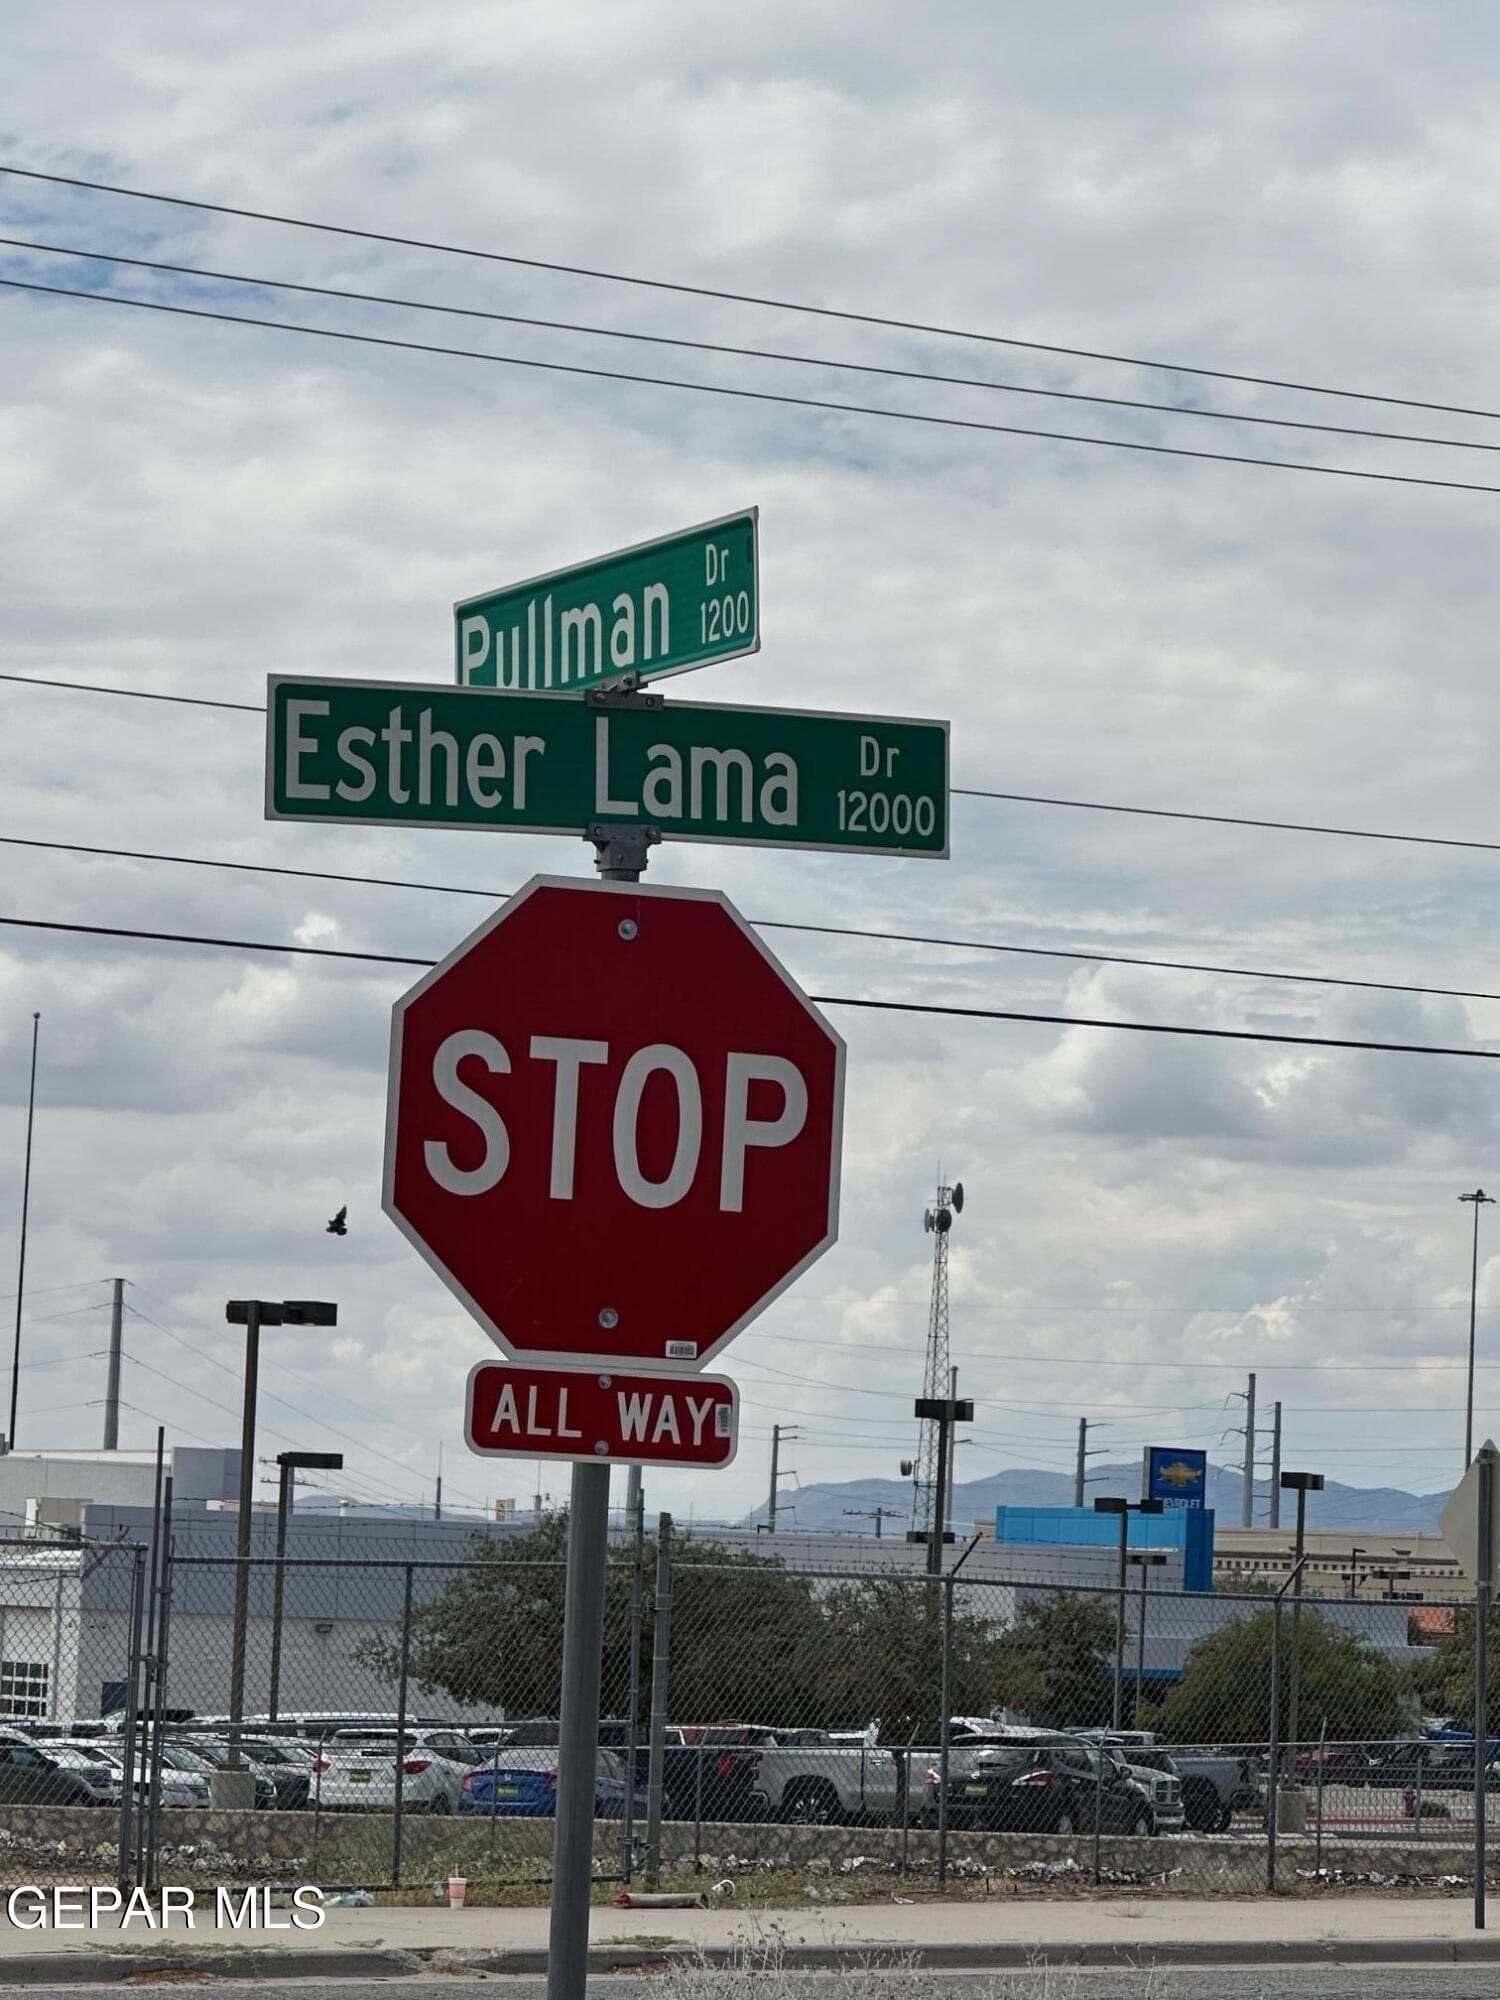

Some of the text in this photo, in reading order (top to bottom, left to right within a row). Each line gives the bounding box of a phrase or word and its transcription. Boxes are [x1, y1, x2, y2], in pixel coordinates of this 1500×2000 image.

[705, 543, 729, 586] Dr
[462, 582, 670, 691] Pullman
[700, 590, 749, 645] 1200
[286, 698, 799, 828] Esther Lama
[860, 736, 900, 778] Dr
[836, 790, 935, 837] 12000
[424, 1029, 809, 1213] STOP
[490, 1383, 715, 1446] ALL WAY
